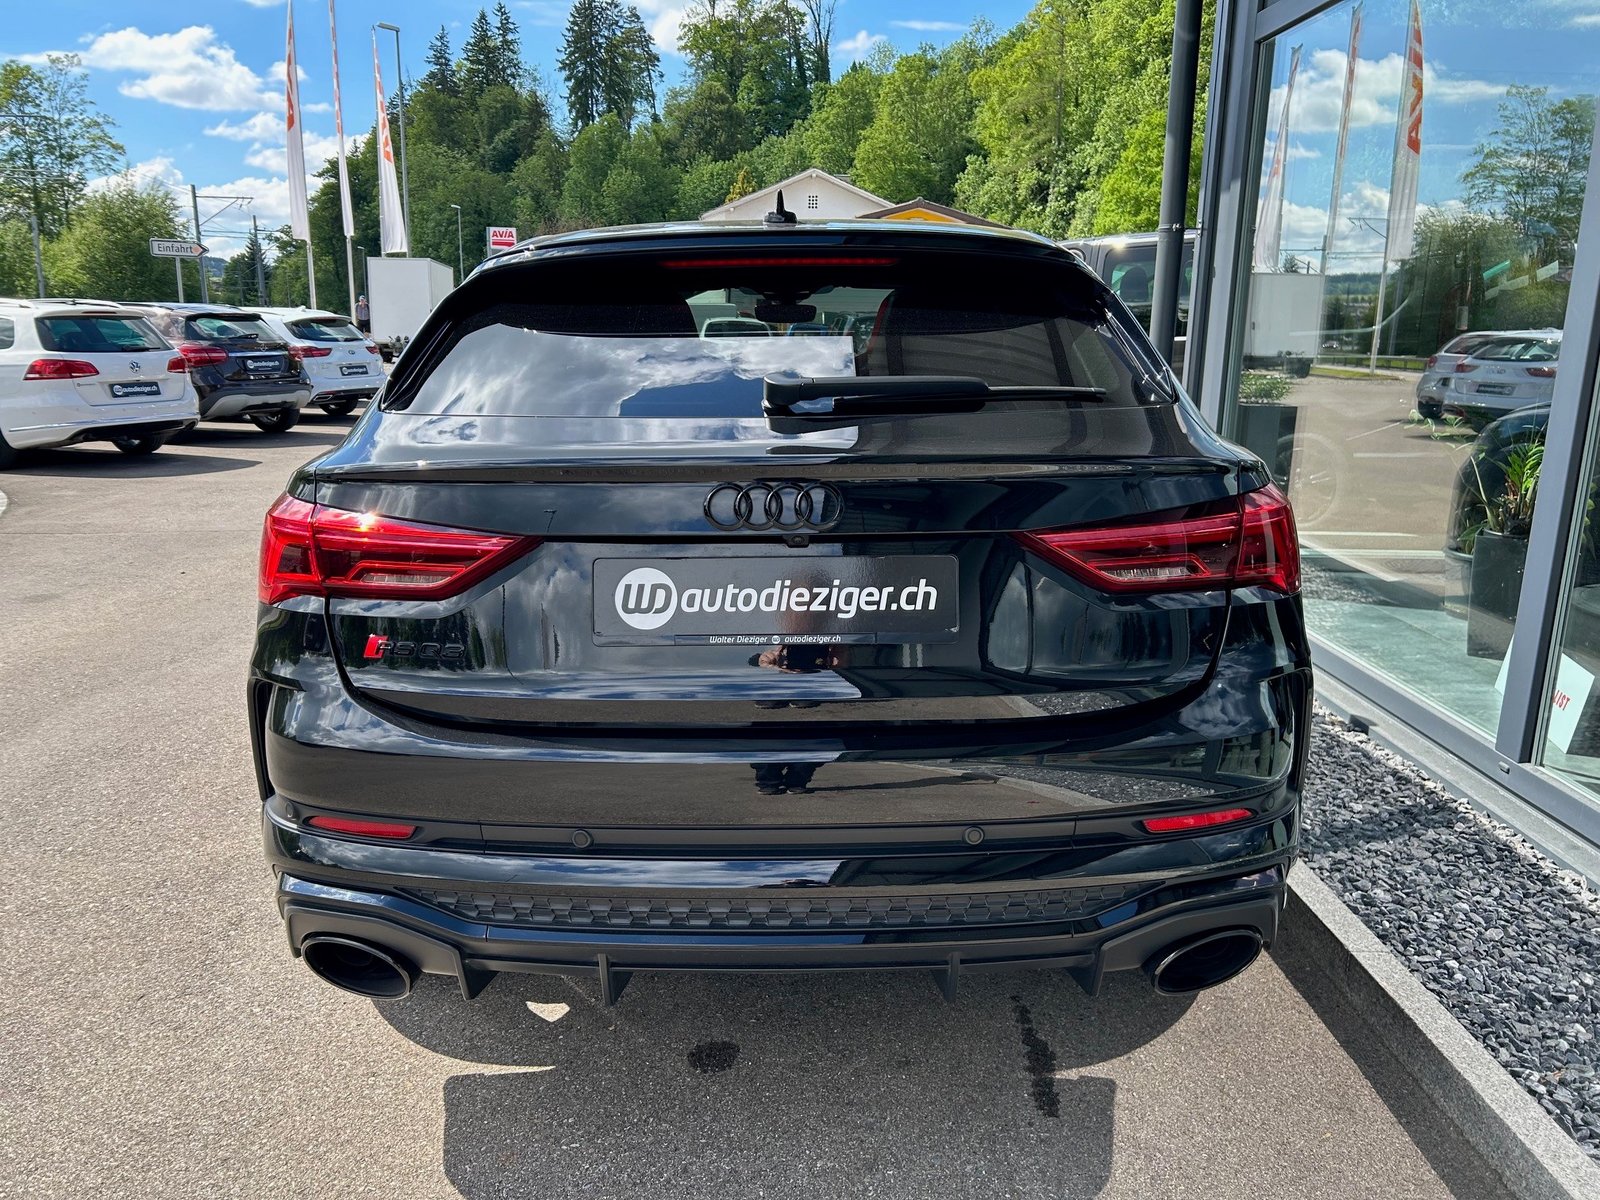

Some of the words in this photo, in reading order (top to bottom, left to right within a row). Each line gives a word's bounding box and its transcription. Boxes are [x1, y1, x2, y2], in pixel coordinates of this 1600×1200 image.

[157, 243, 193, 254] Einfahrt
[680, 578, 938, 618] autodieziger.ch
[709, 635, 735, 644] Walter
[736, 635, 768, 645] Dieziger
[784, 635, 842, 645] autodieziger.ch
